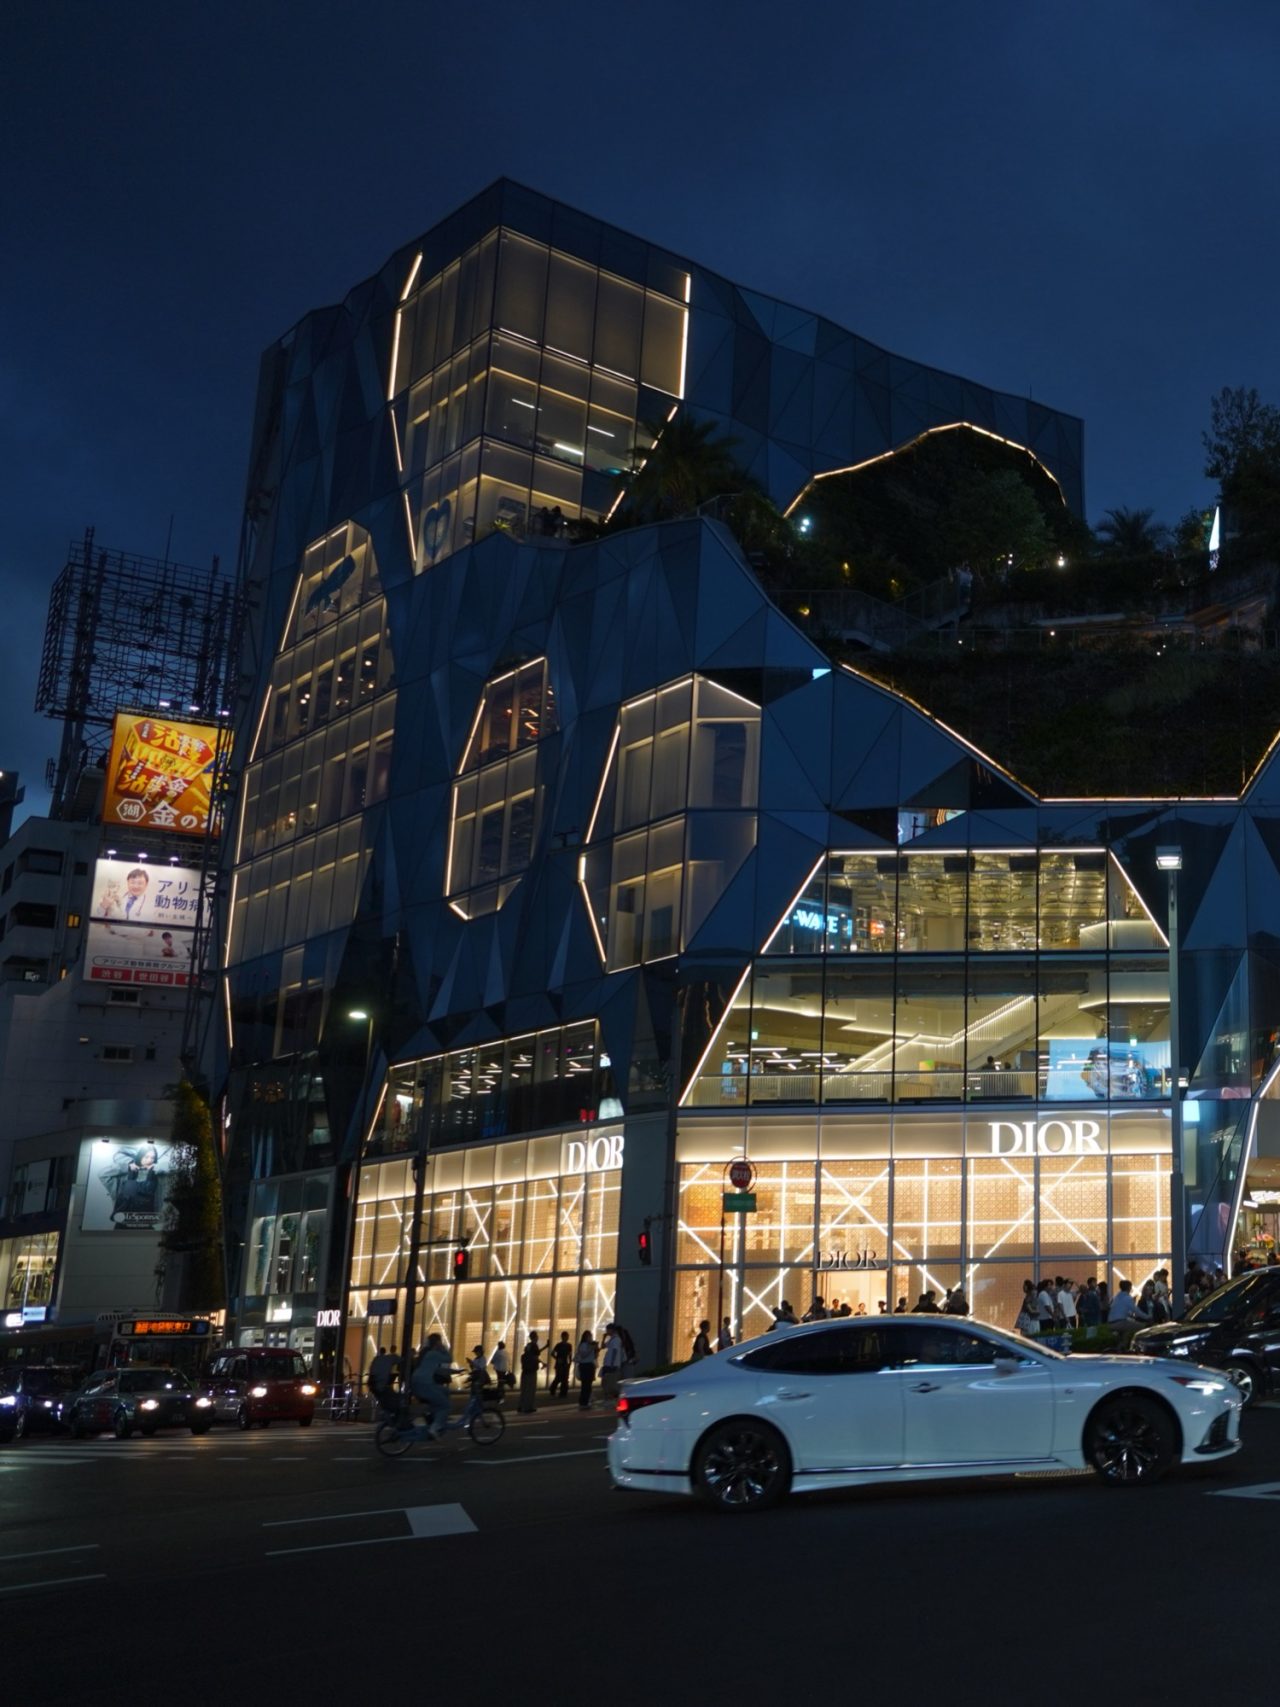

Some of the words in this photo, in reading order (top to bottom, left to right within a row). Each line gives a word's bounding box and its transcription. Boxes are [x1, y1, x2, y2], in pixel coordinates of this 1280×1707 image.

[987, 1120, 1104, 1156] DIOR
[816, 1249, 880, 1271] DIOR
[316, 1309, 341, 1327] DIOR
